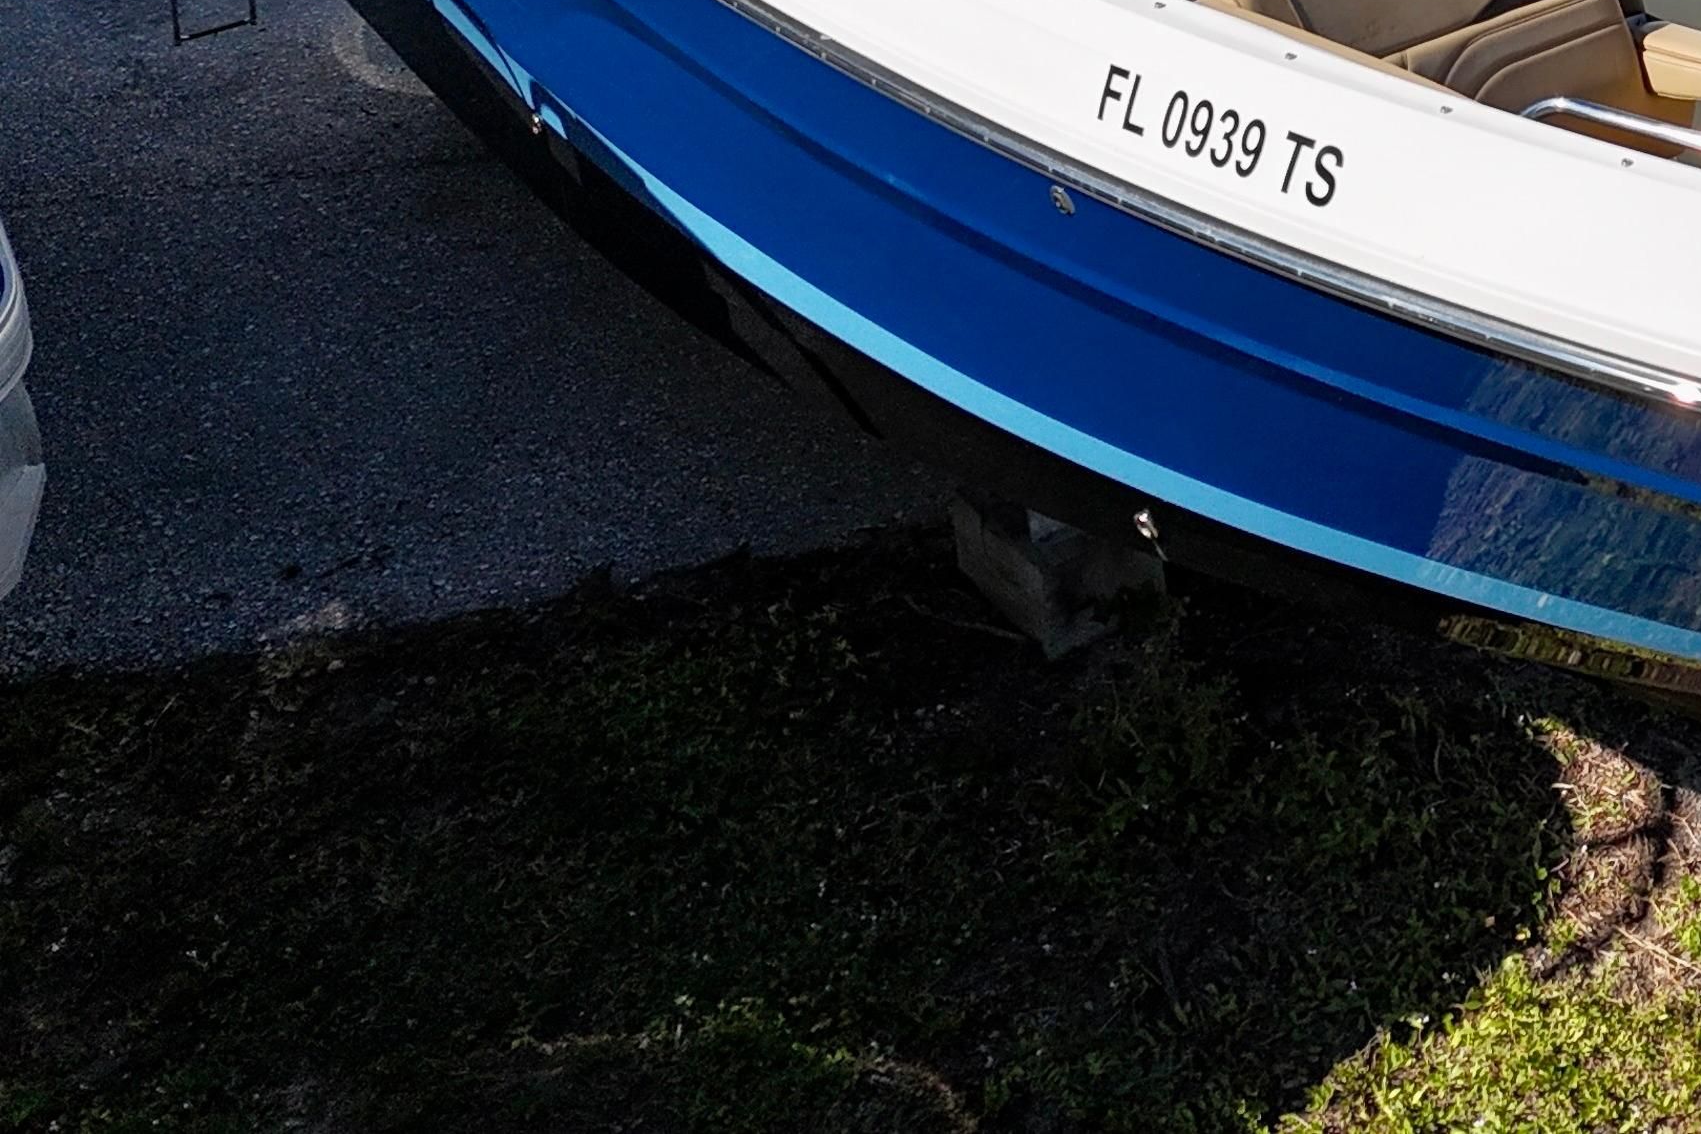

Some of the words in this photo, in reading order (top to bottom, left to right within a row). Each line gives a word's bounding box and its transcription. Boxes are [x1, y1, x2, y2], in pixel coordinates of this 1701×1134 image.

[1096, 63, 1145, 138] FL
[1161, 89, 1267, 179] 0939
[1280, 129, 1345, 208] TS
